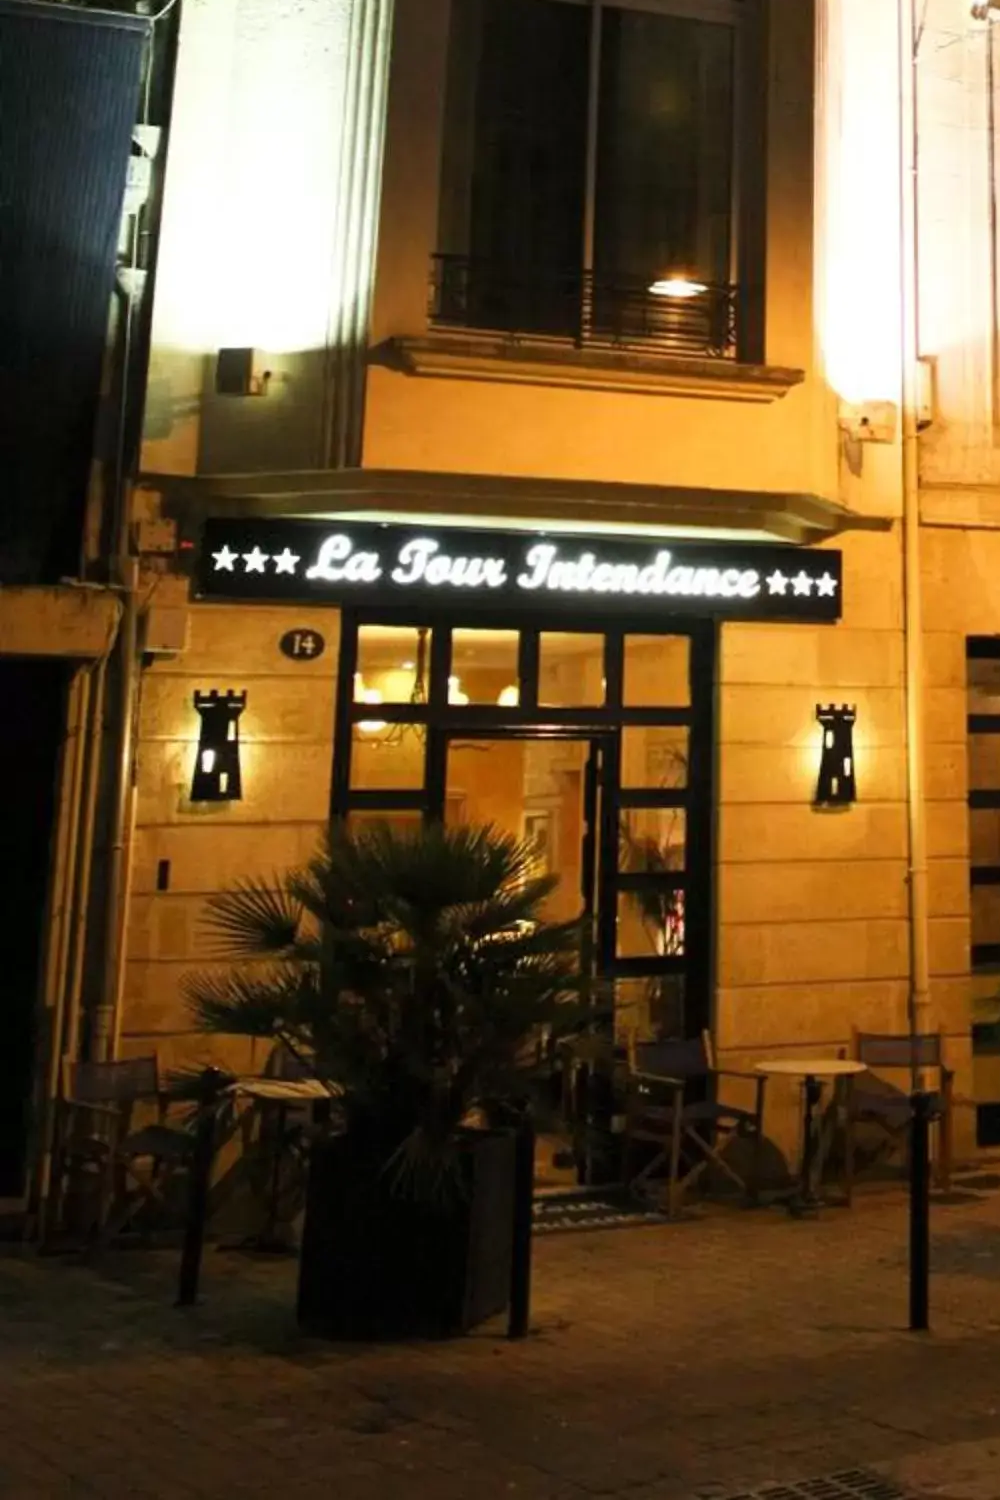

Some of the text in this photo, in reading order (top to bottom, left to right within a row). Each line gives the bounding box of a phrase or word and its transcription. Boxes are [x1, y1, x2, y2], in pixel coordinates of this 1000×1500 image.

[305, 533, 761, 598] La Tour Intendance
[293, 633, 316, 655] 14
